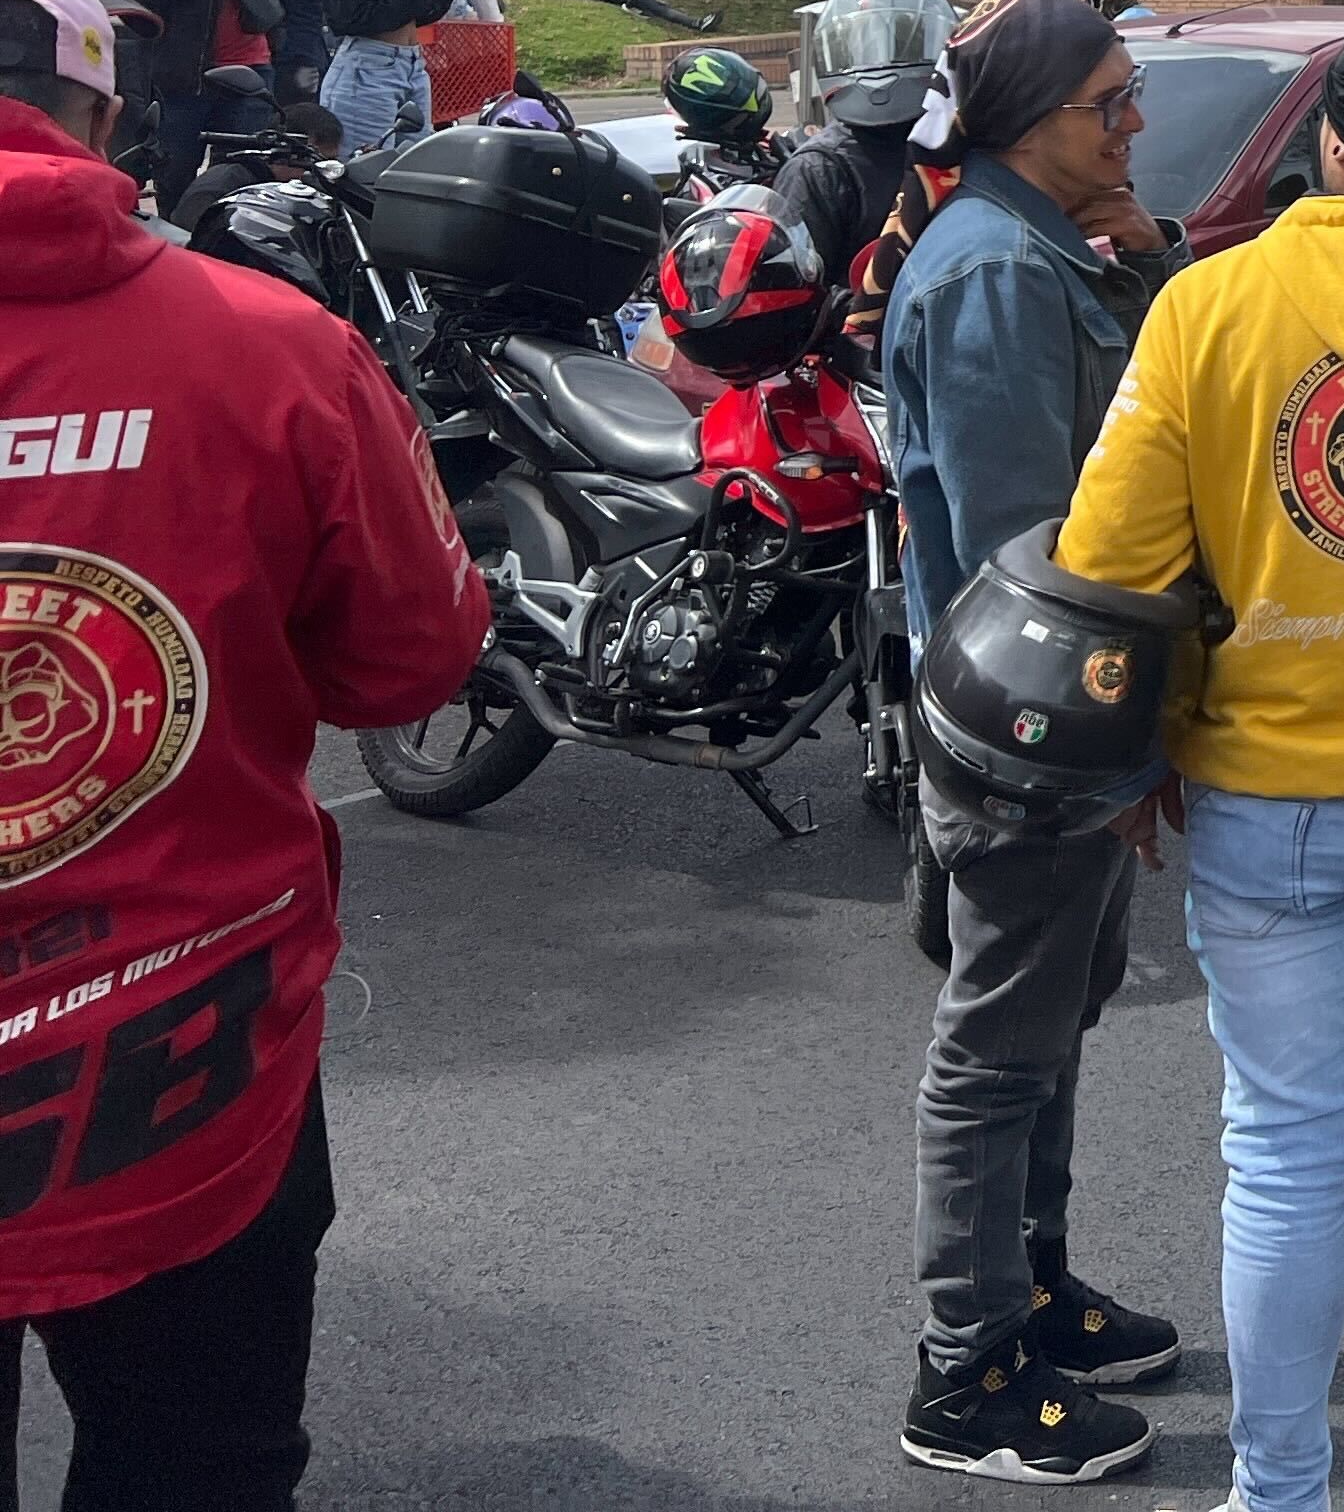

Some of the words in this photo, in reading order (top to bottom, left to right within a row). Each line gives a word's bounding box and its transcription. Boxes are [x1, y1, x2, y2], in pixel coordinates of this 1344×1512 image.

[1282, 359, 1331, 422] HUMILDAD
[1274, 431, 1290, 491] RESPETO
[46, 971, 115, 1022] LOS
